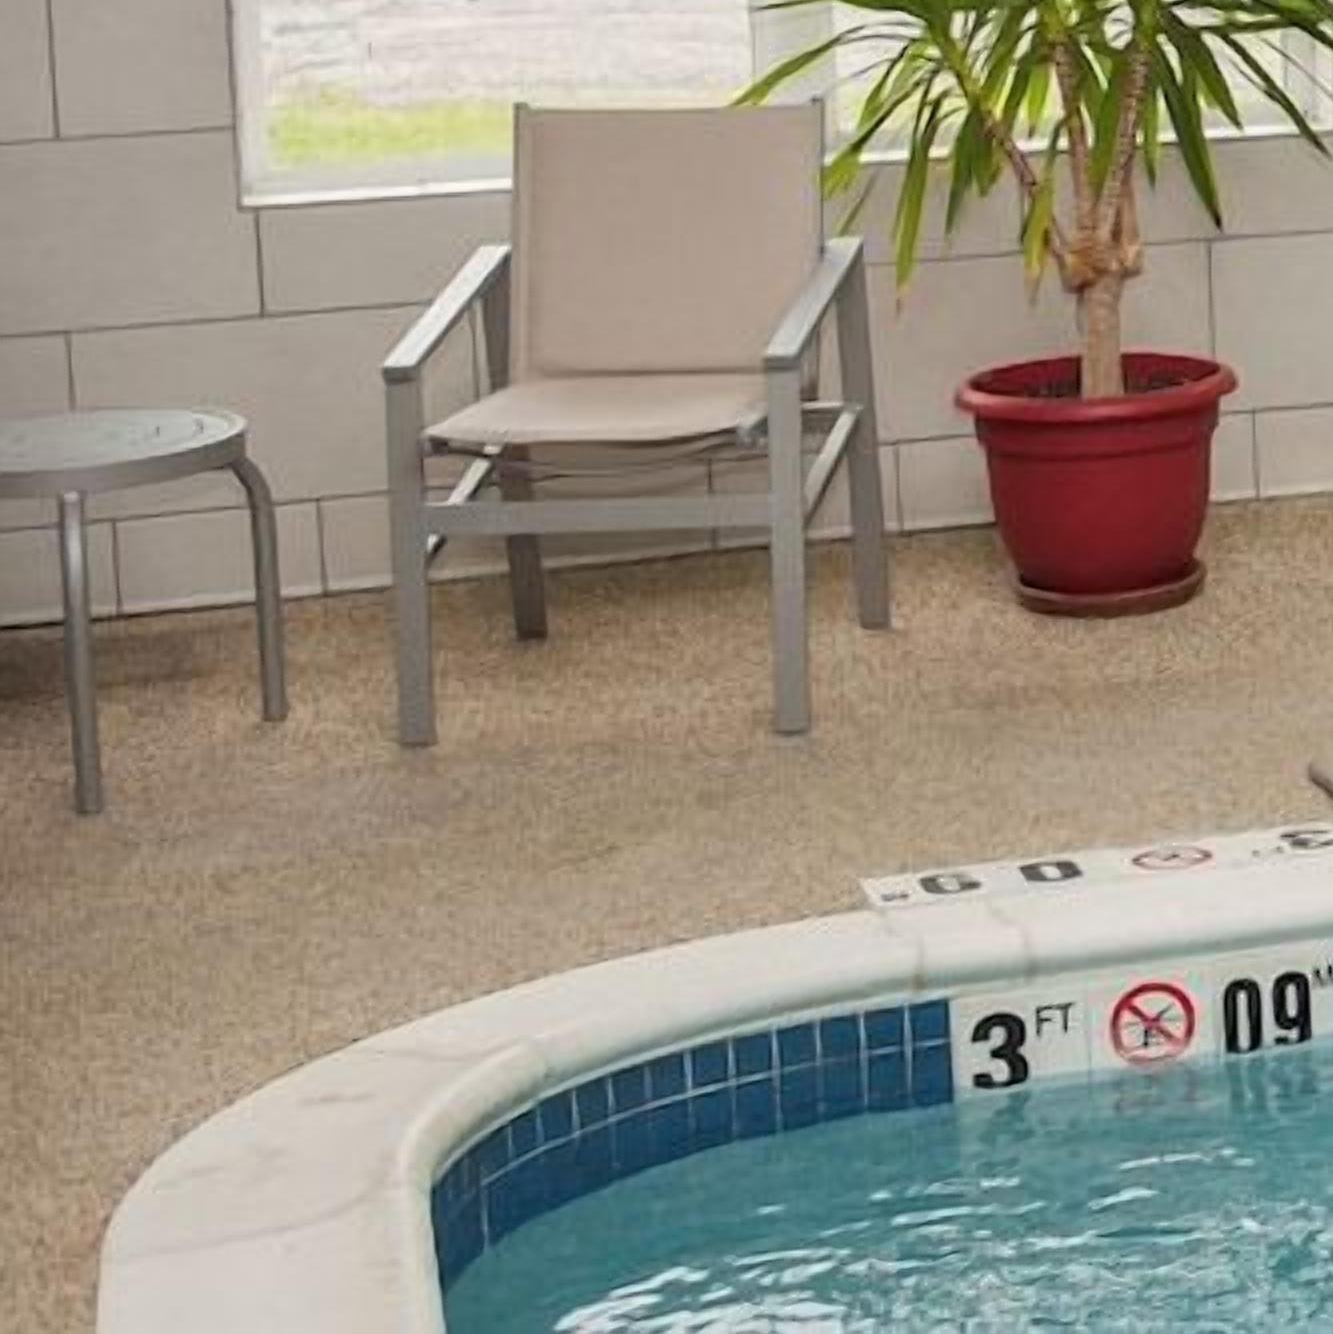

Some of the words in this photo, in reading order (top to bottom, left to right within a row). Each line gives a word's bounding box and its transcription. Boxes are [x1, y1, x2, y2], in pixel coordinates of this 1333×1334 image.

[971, 1012, 1029, 1089] 3
[1035, 1002, 1074, 1037] FT
[1223, 971, 1312, 1054] 09
